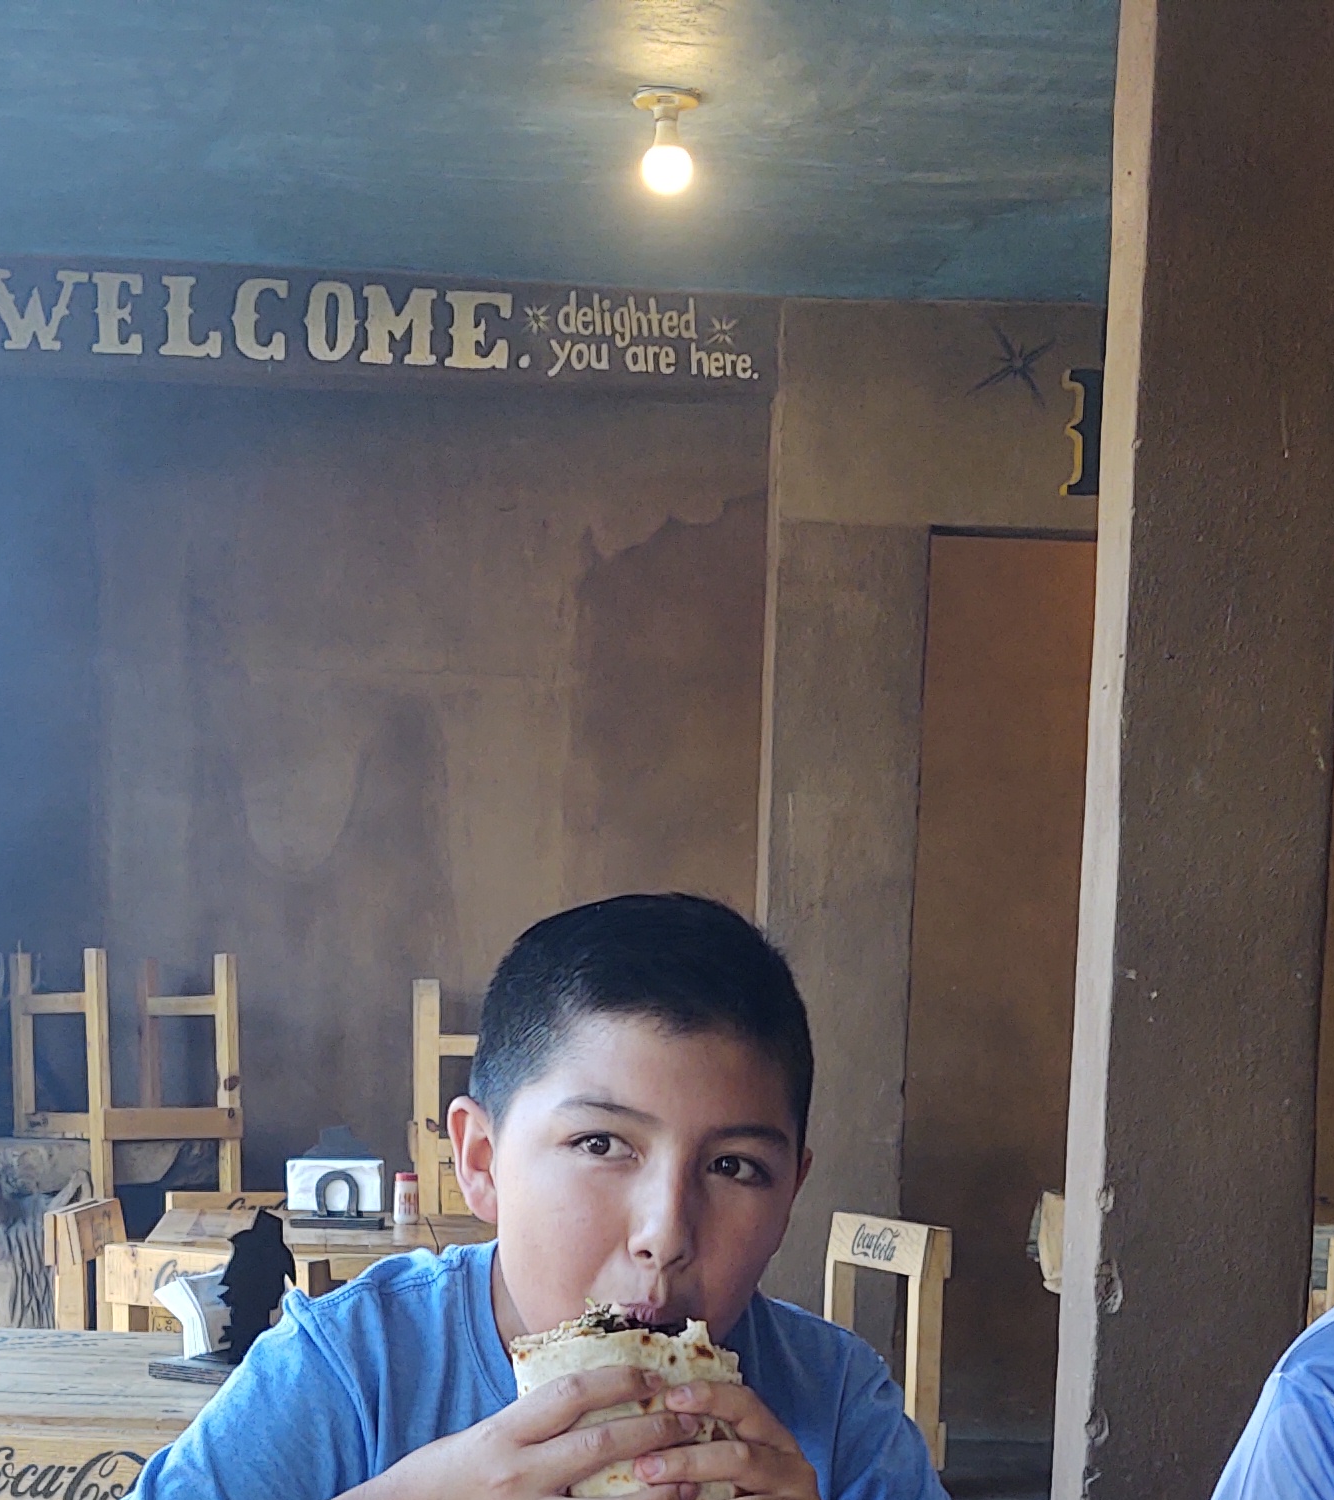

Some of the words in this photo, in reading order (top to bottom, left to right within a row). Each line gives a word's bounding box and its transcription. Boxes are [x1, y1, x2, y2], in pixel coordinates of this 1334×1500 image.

[557, 290, 698, 348] delighted
[547, 339, 610, 377] you
[625, 344, 676, 374] are
[690, 342, 760, 379] here.
